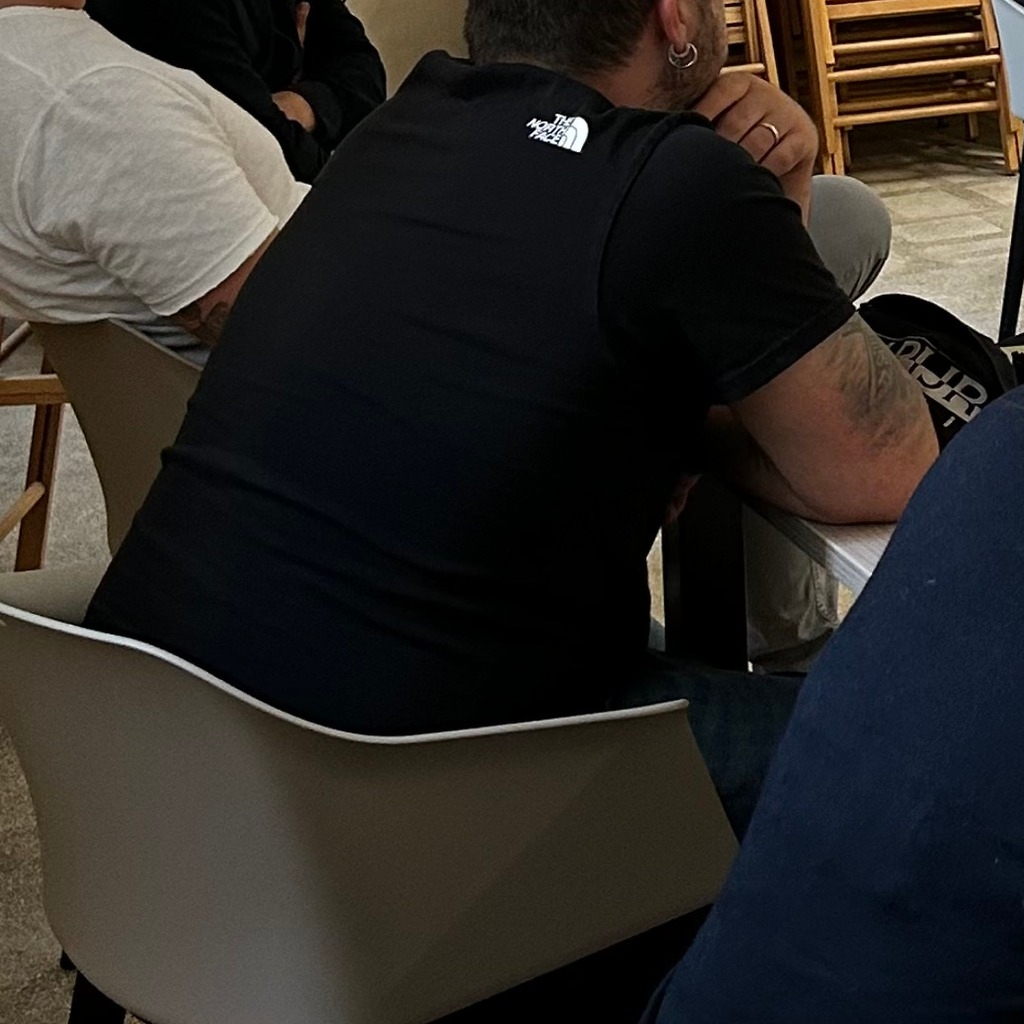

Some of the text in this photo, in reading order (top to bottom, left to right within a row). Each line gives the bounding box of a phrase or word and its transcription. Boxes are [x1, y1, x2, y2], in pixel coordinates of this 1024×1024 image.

[526, 118, 571, 135] NORTH
[554, 113, 575, 127] THE
[528, 130, 562, 145] FACE
